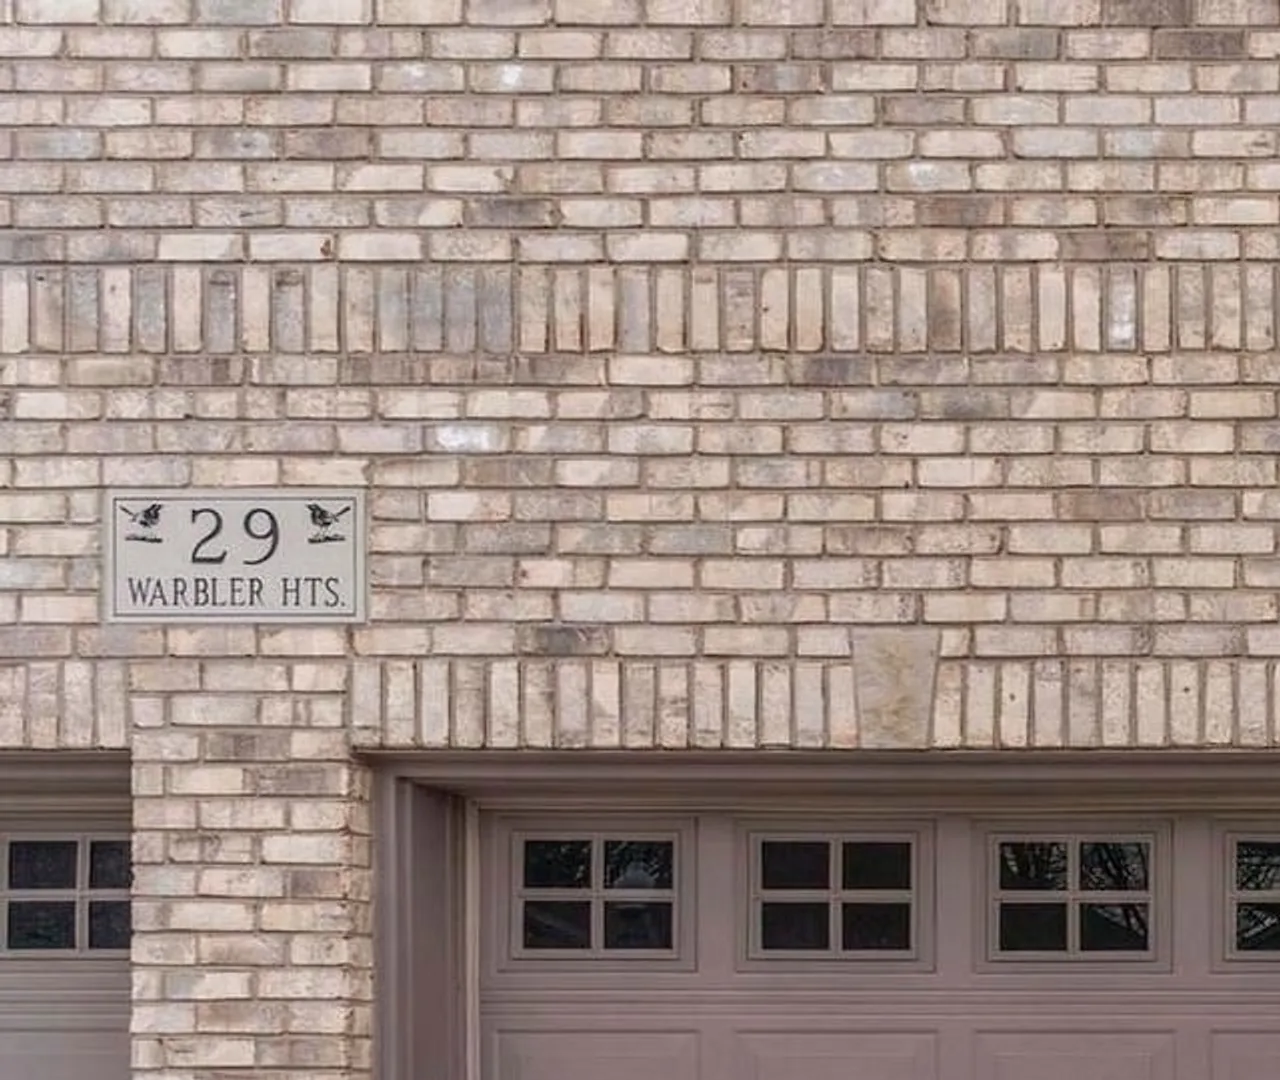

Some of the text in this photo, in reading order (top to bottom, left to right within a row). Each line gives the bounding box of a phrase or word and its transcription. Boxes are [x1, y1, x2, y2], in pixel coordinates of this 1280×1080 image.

[189, 508, 280, 565] 29
[128, 577, 345, 607] WARBLER HTS.
